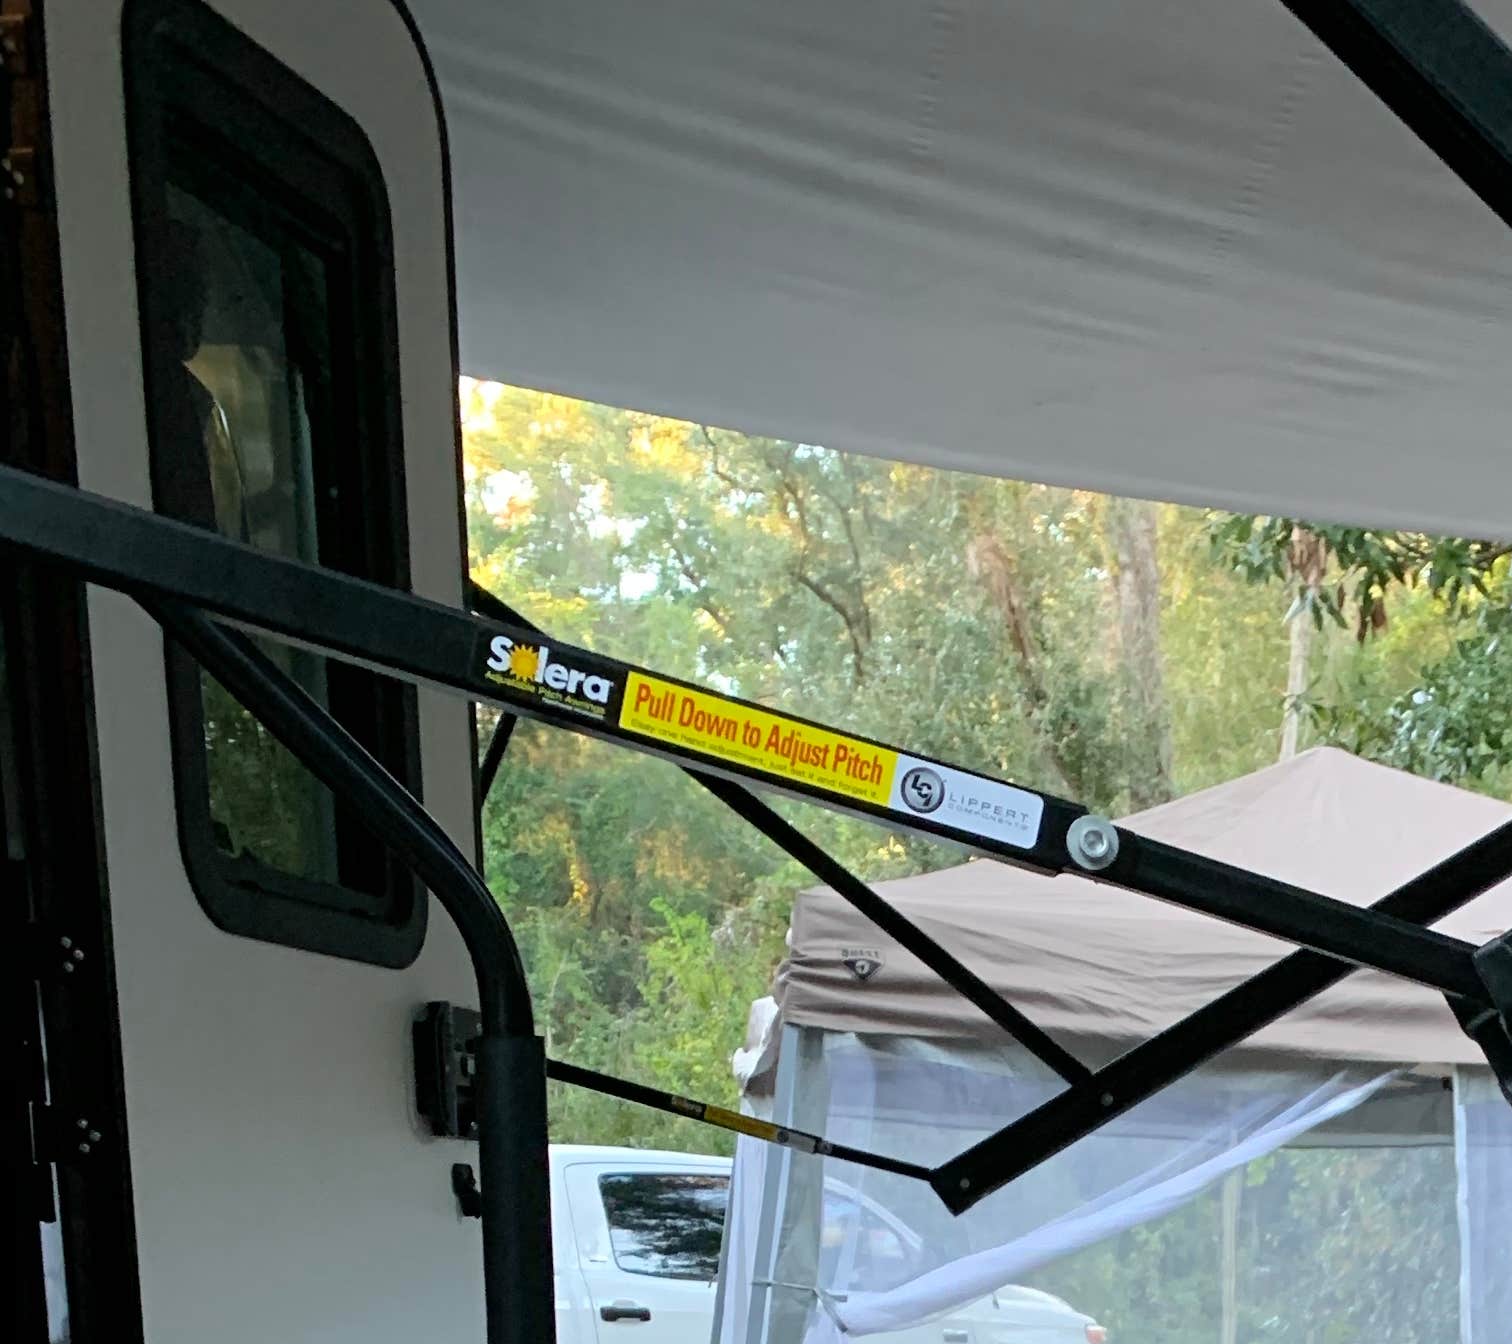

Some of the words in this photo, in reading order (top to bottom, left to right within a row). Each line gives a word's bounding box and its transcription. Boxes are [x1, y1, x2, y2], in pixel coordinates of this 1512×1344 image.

[486, 635, 611, 703] Solera
[634, 683, 674, 722] Pull
[681, 697, 738, 741] Down
[743, 719, 762, 749] to
[764, 724, 829, 770] Adjust
[833, 743, 883, 785] Pitch
[948, 791, 1029, 820] LIPPERT
